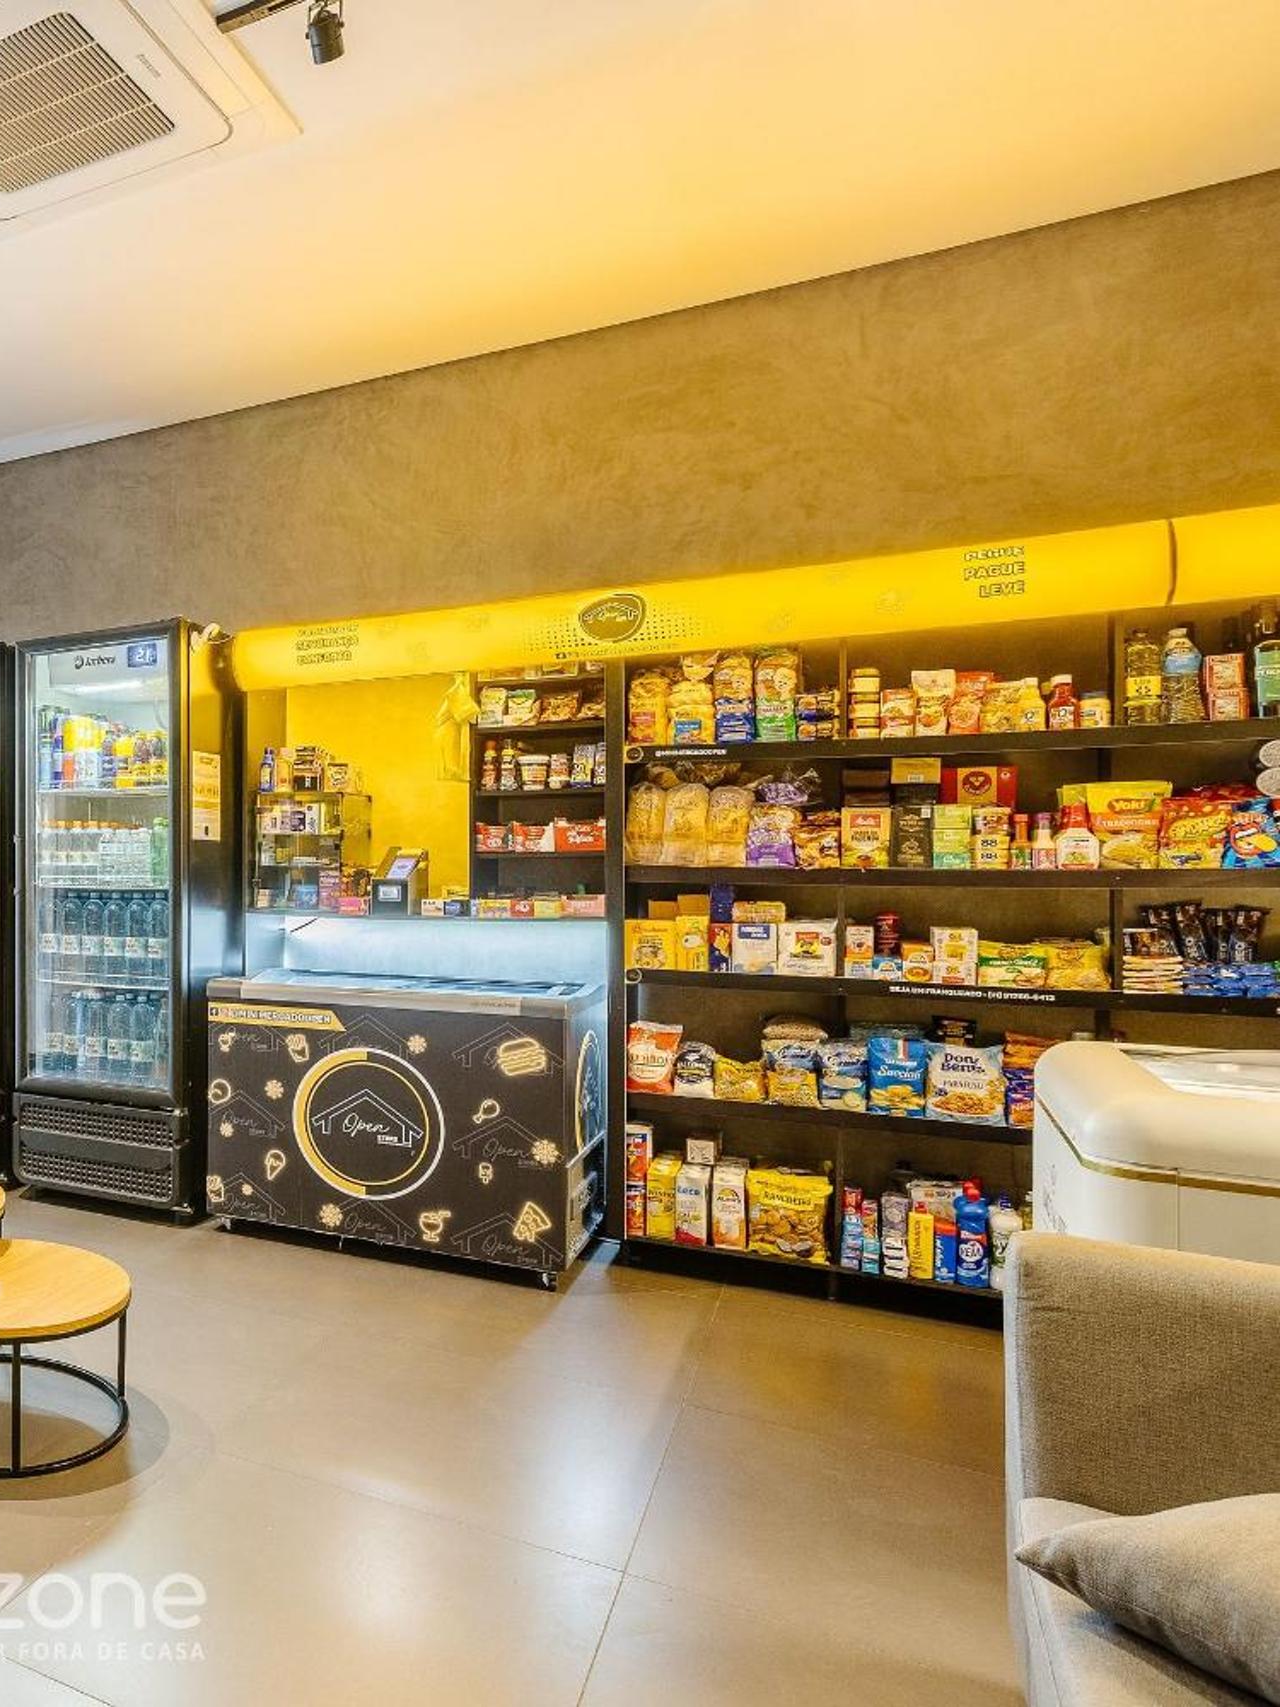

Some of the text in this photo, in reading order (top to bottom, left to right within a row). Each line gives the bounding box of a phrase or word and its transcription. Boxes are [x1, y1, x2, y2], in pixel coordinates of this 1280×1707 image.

[964, 561, 1024, 581] PAGUE
[979, 580, 1024, 598] LEVE
[343, 1112, 390, 1137] Open
[482, 1138, 531, 1163] Open
[481, 1234, 529, 1257] Open
